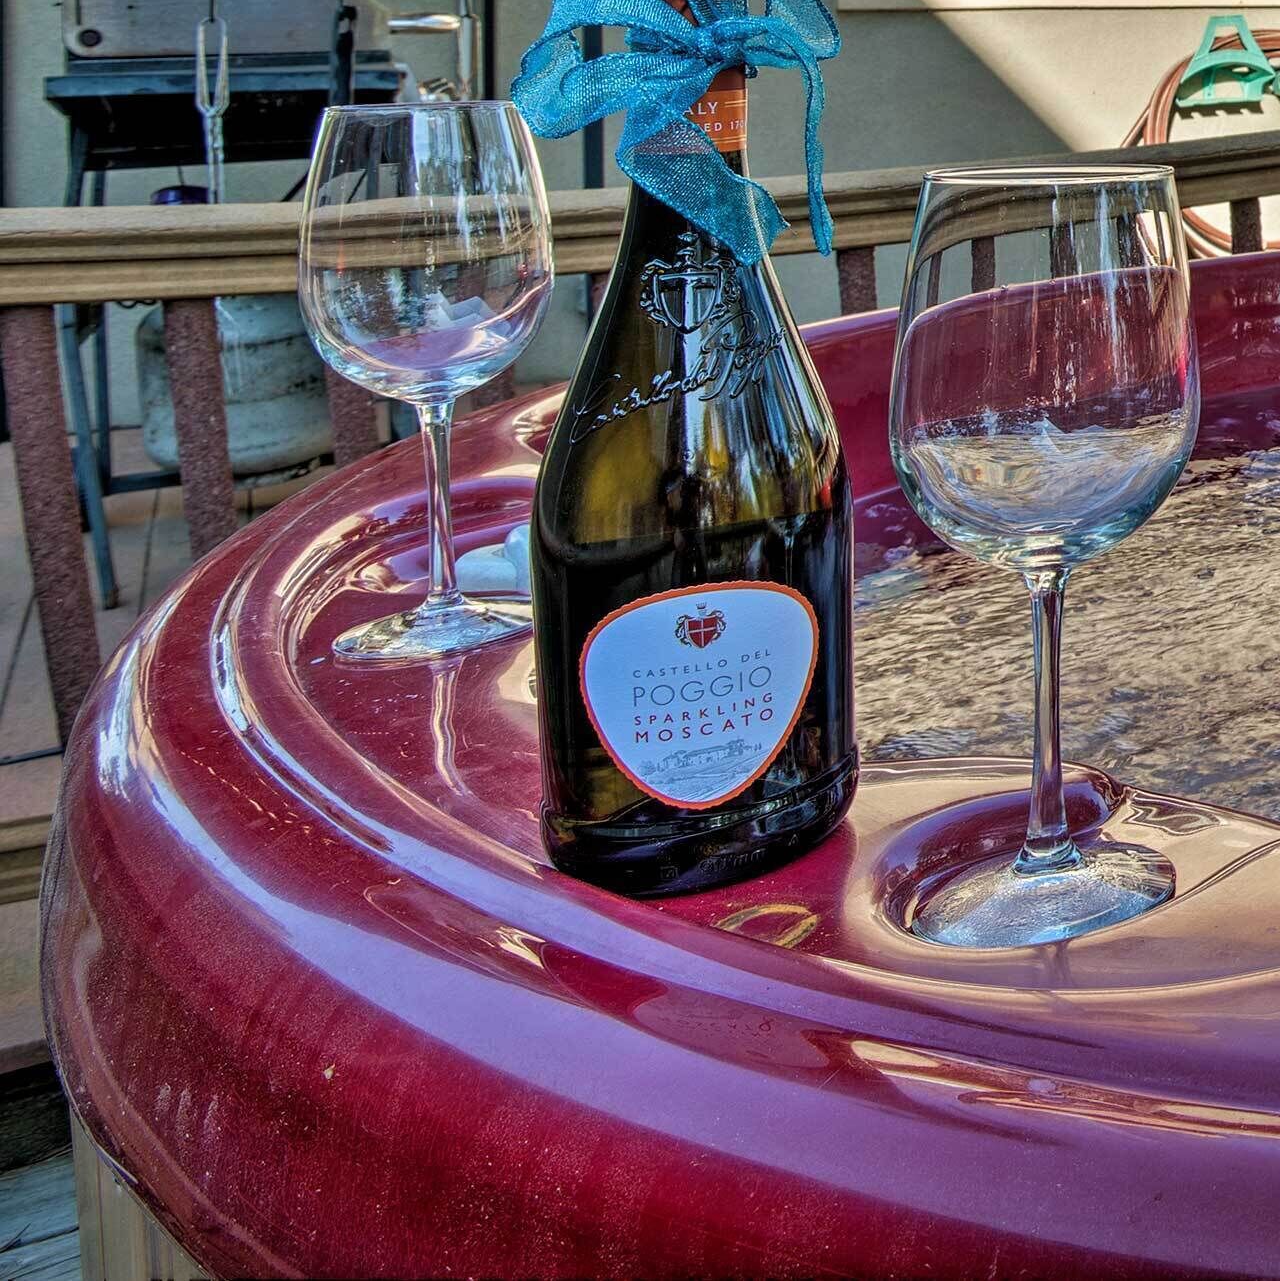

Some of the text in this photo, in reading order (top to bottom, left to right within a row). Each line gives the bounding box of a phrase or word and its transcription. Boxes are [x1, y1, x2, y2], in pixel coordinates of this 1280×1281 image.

[683, 101, 719, 115] ALY
[632, 649, 771, 679] CASTELLO DEL
[632, 666, 772, 707] POGGIO
[634, 692, 773, 727] SPARKLING
[634, 708, 773, 744] MOSCATO
